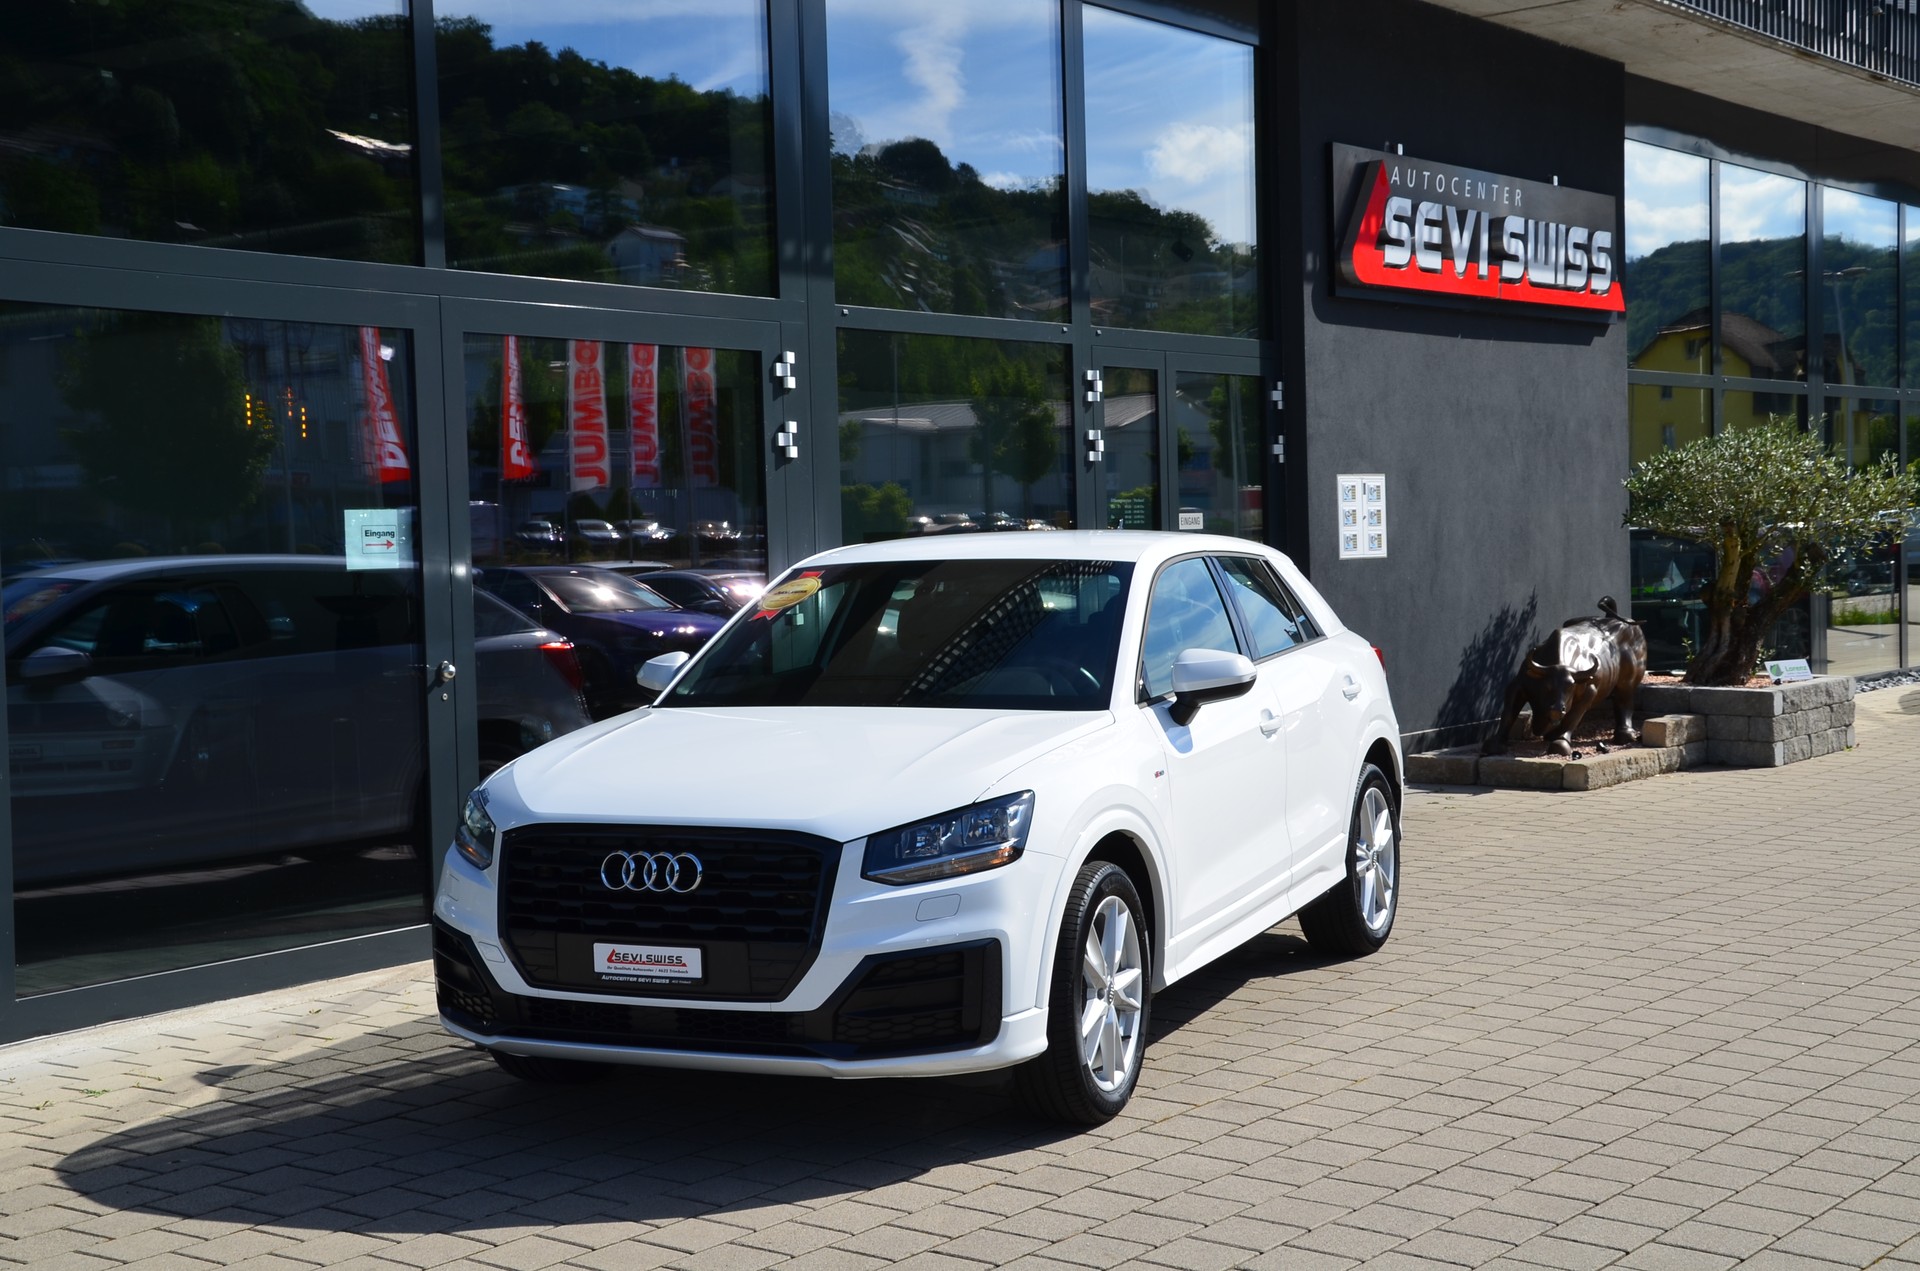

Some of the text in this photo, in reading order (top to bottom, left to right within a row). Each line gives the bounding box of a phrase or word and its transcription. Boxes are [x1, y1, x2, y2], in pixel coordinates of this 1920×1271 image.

[1391, 166, 1522, 207] AUTOCENTER
[1383, 196, 1613, 296] SEVI SWISS
[1180, 516, 1201, 526] EINGANG
[364, 529, 395, 538] Eingang
[614, 952, 683, 964] SEVI SWISS
